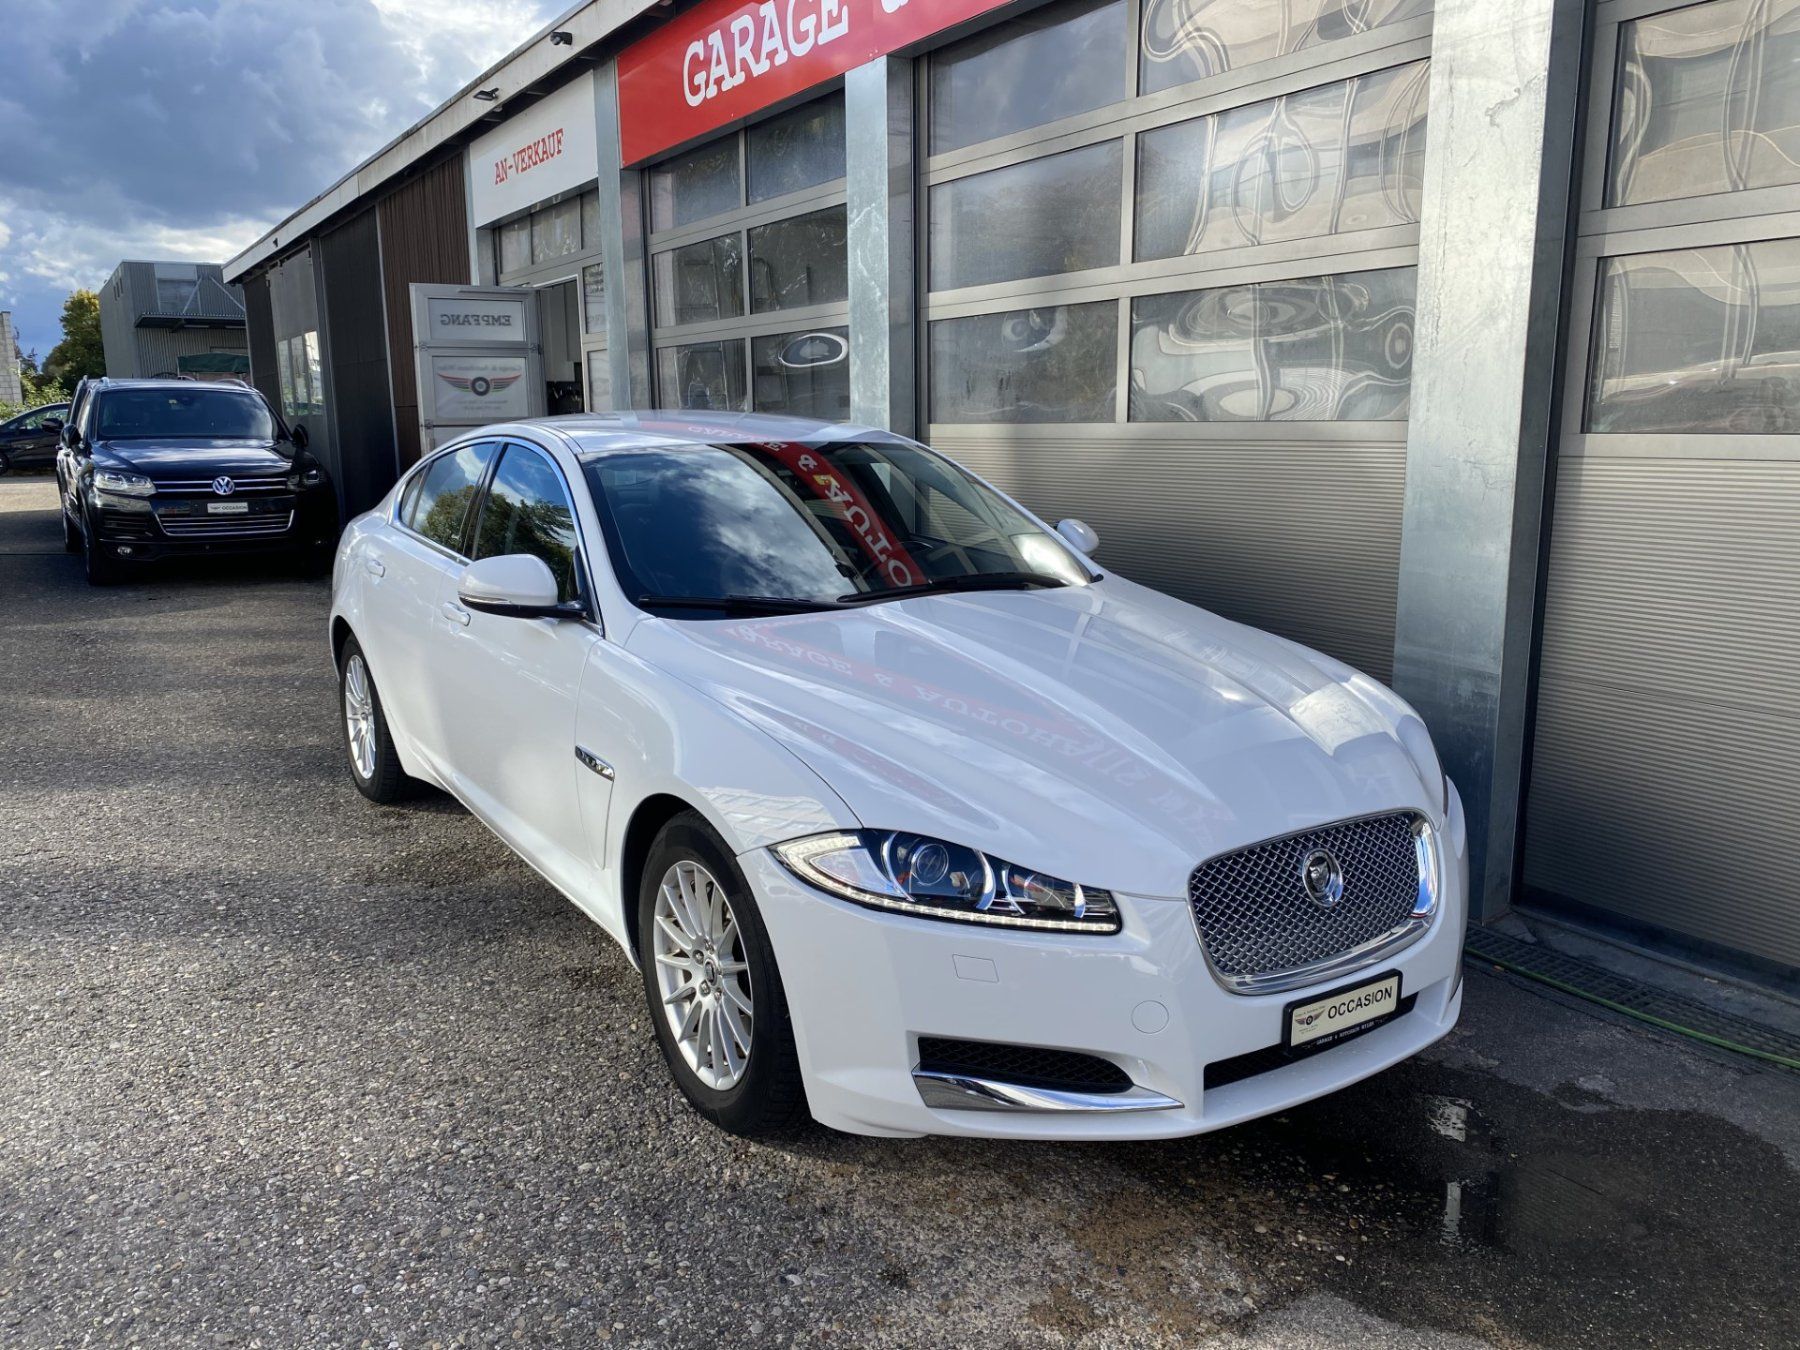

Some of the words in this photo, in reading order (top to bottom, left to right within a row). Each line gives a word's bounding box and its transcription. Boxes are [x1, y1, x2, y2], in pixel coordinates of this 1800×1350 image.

[683, 0, 848, 107] GARAGE
[495, 127, 564, 185] AN-VERKAUF
[1327, 985, 1393, 1019] OCCASION
